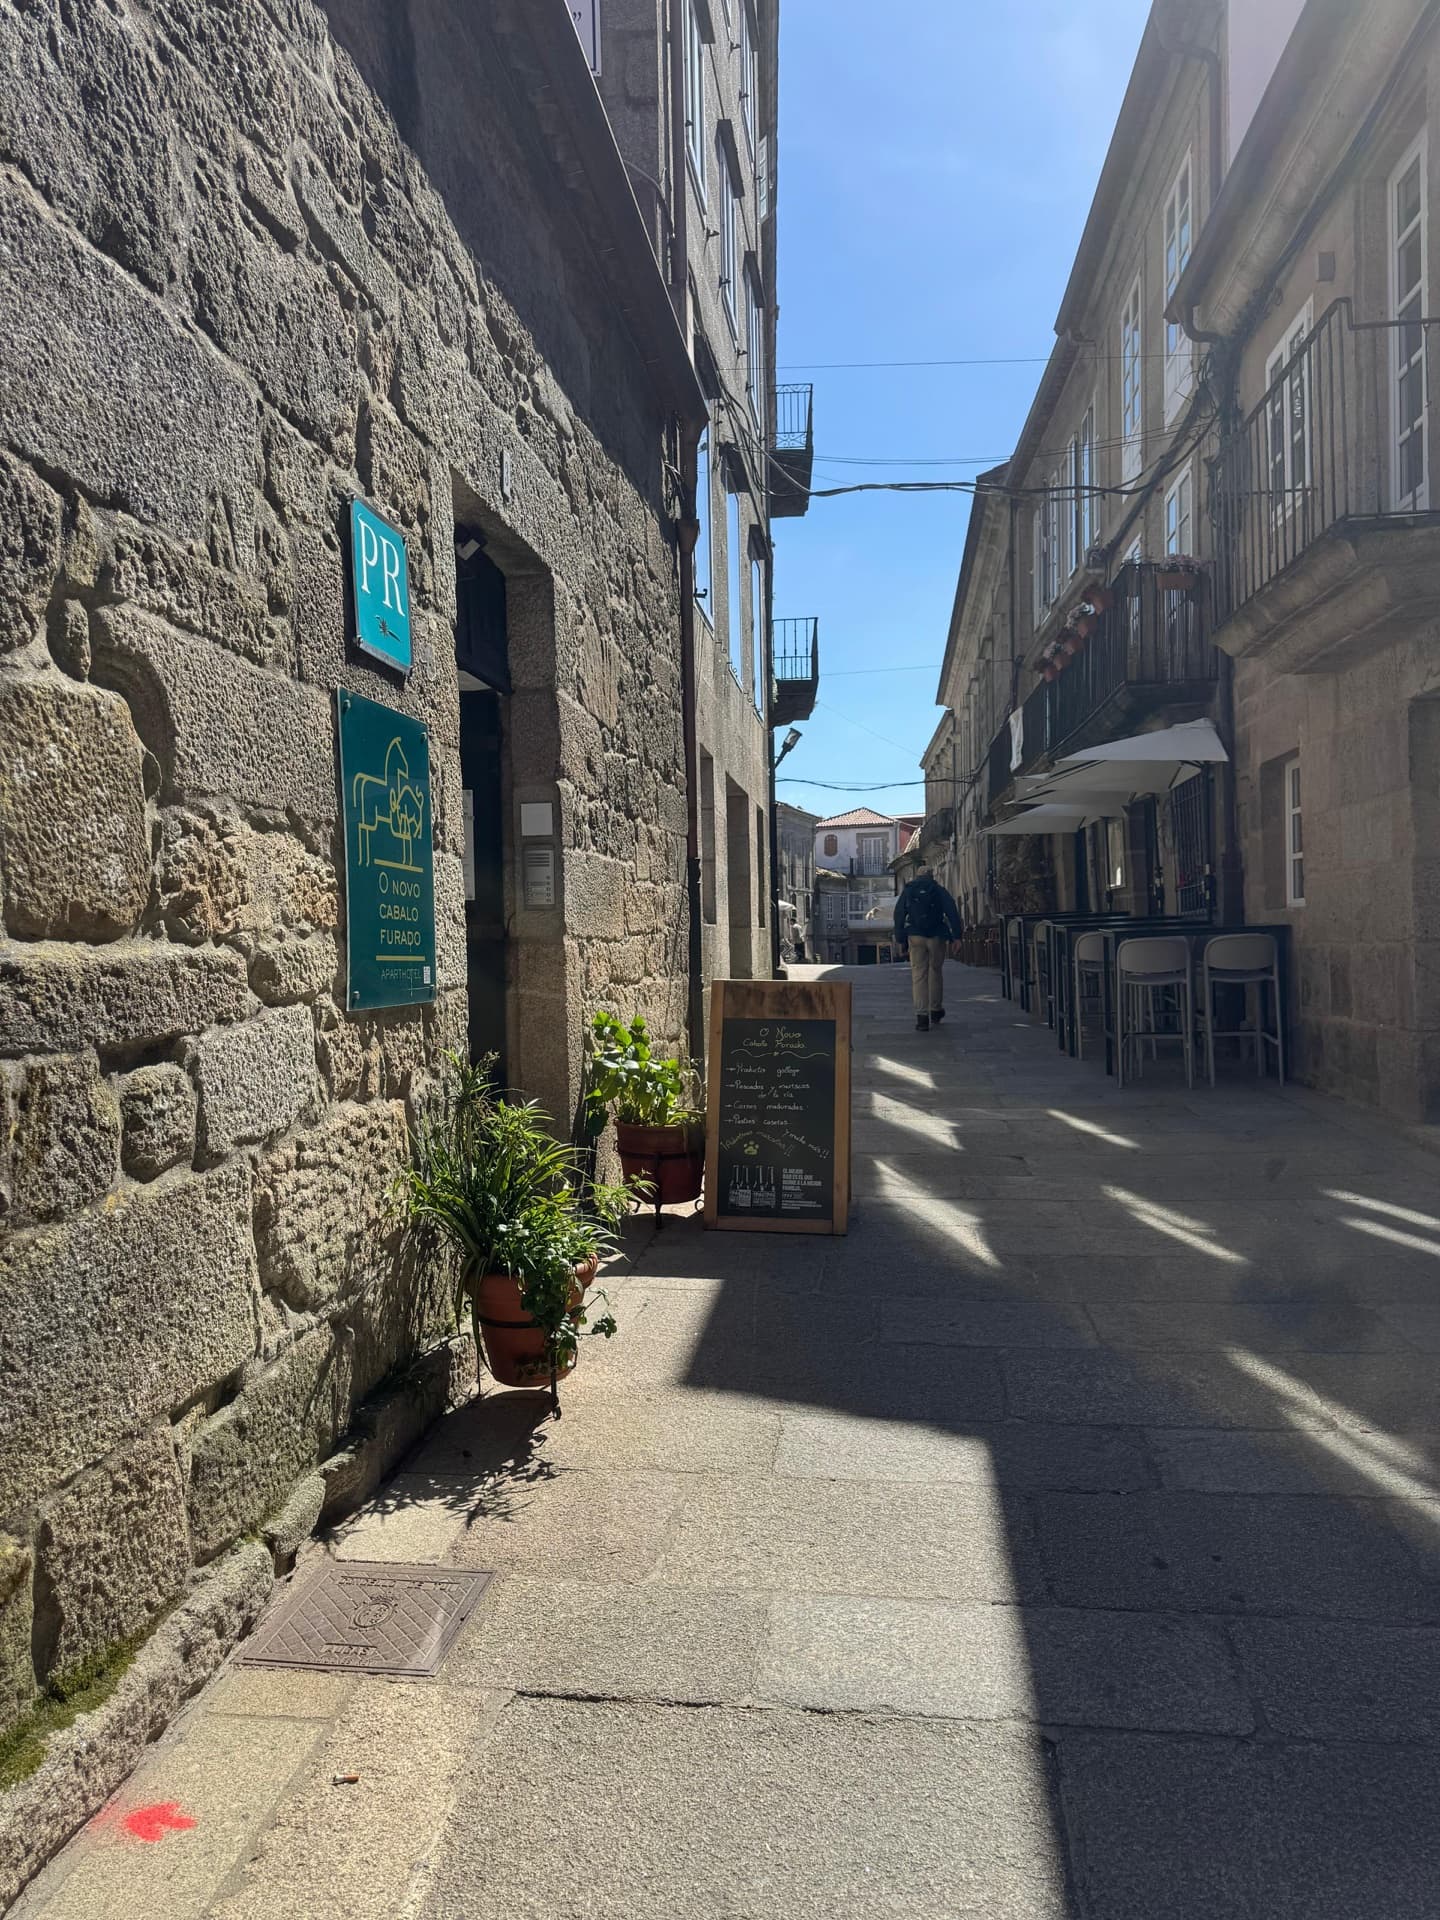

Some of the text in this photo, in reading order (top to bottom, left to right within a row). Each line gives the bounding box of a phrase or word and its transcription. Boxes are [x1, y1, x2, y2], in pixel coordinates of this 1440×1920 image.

[358, 513, 405, 616] PR
[379, 872, 420, 898] O NOVO
[380, 904, 419, 921] CABALO
[380, 929, 421, 945] FURADO
